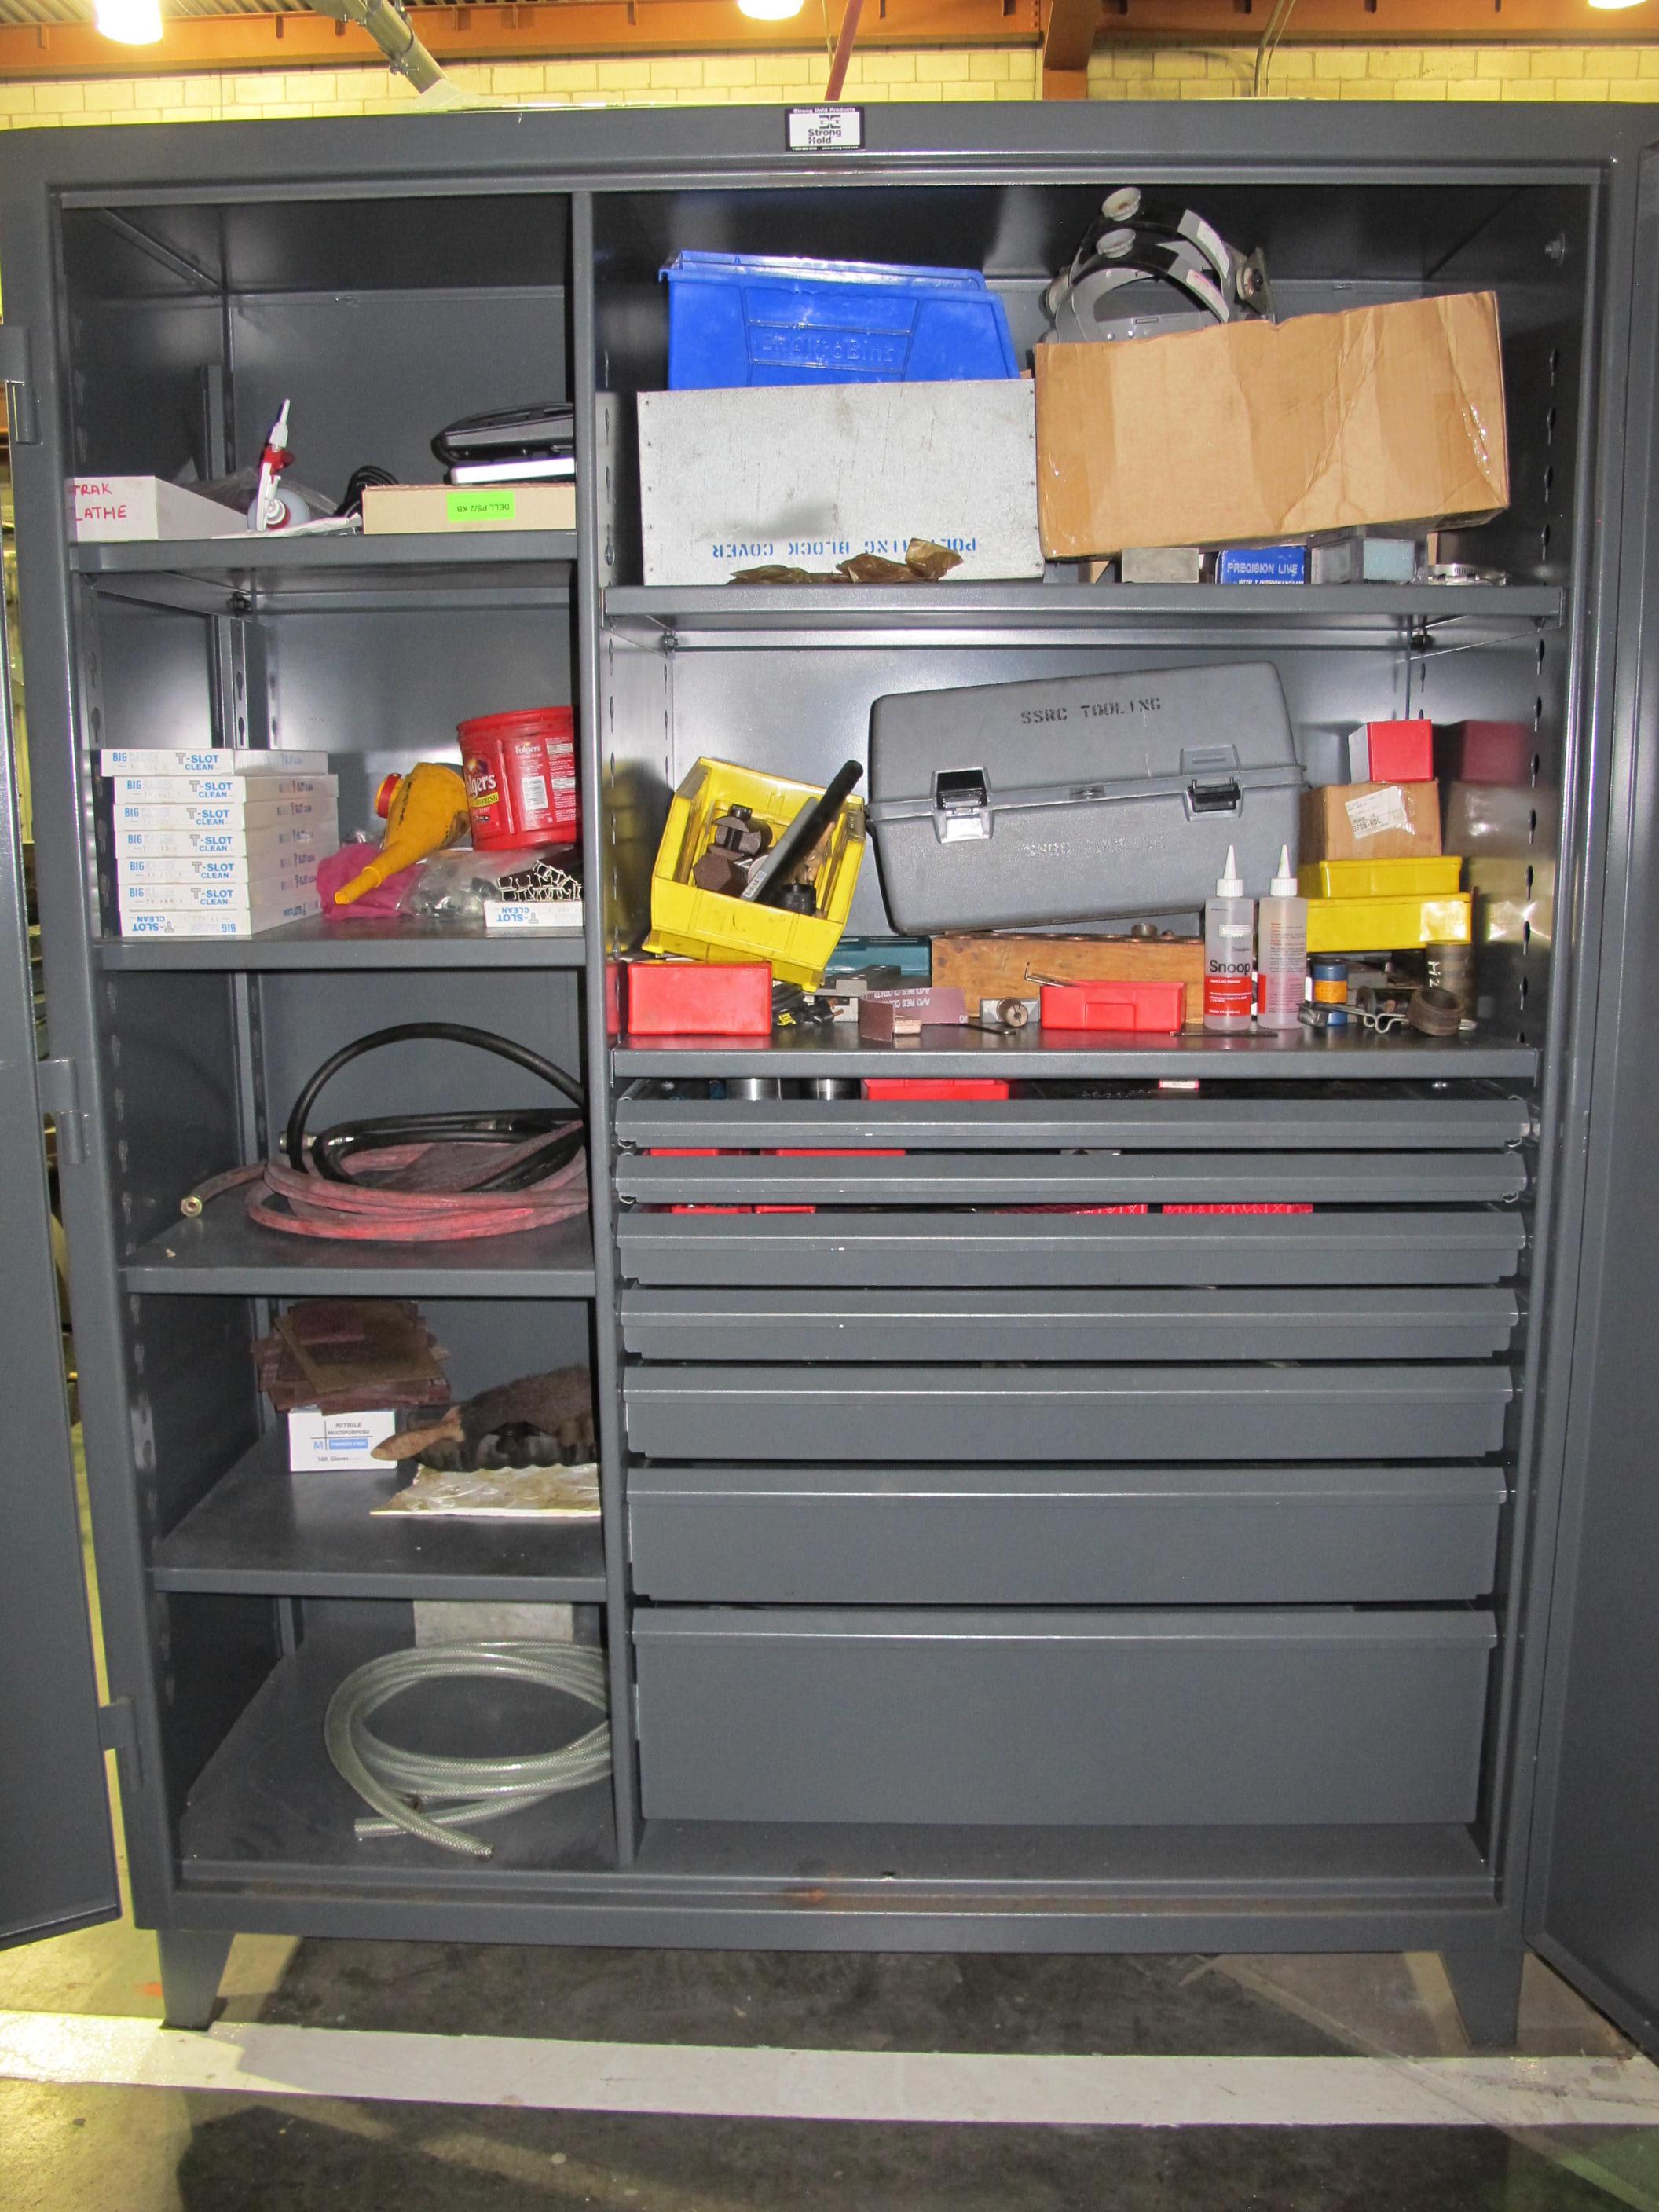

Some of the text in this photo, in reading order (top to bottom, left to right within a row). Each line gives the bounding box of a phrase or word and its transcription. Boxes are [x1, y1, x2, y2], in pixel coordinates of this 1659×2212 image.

[808, 128, 842, 137] Strong
[808, 136, 832, 145] Hold
[712, 542, 774, 558] COVER
[788, 540, 850, 556] BLOCK
[1227, 562, 1274, 574] PRECISION
[1278, 563, 1298, 574] LIVE
[1020, 698, 1161, 724] SSRC TOOLING
[112, 752, 127, 762] BIG
[176, 753, 219, 764] T-SLOT
[126, 780, 141, 789] BIG
[189, 780, 233, 792] T-SLOT
[468, 775, 496, 799] lgers
[124, 808, 139, 817] BIG
[187, 808, 229, 819] T-SLOT
[128, 834, 142, 844] BIG
[190, 834, 233, 846] T-SLOT
[130, 861, 145, 871] BIG
[192, 861, 234, 873] T-SLOT
[130, 888, 144, 897] BIG
[191, 888, 233, 899] T-SLOT
[496, 913, 539, 924] T-SLOT
[132, 921, 174, 933] T-SLOT
[222, 923, 236, 932] BIG
[1210, 960, 1251, 976] Snoop
[313, 1441, 324, 1449] M
